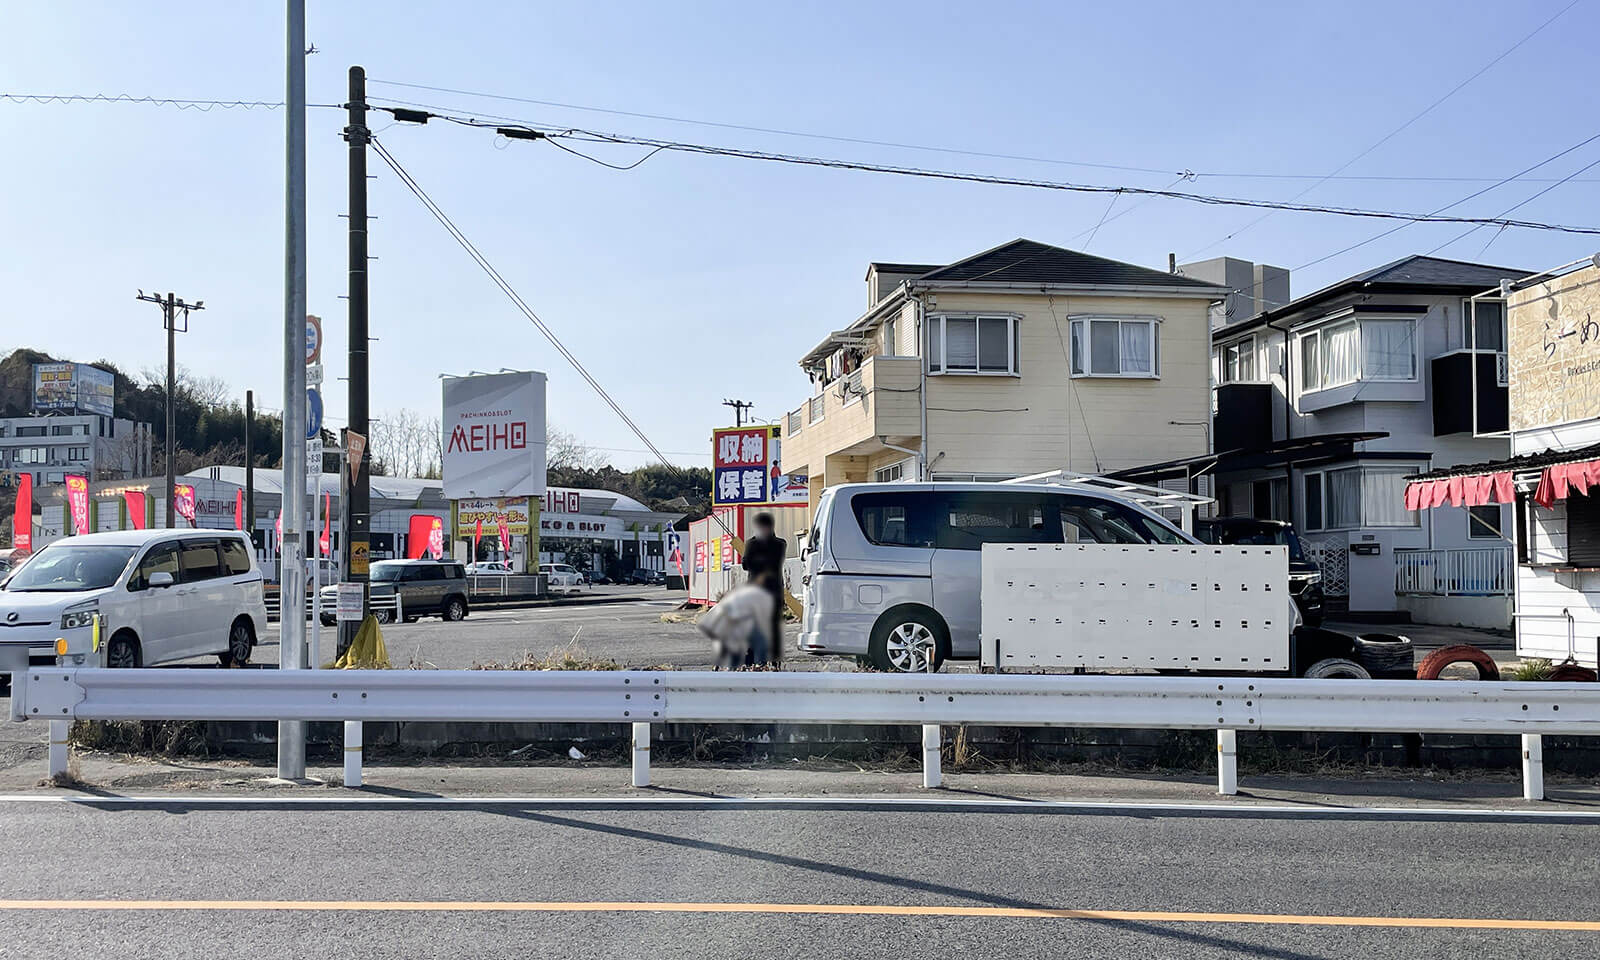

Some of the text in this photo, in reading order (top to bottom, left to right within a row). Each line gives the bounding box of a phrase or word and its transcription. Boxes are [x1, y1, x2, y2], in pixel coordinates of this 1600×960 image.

[460, 409, 513, 419] PACHINKO&SLOT
[447, 421, 527, 454] MEIHO
[719, 433, 764, 464] 収納
[719, 470, 764, 500] 保管
